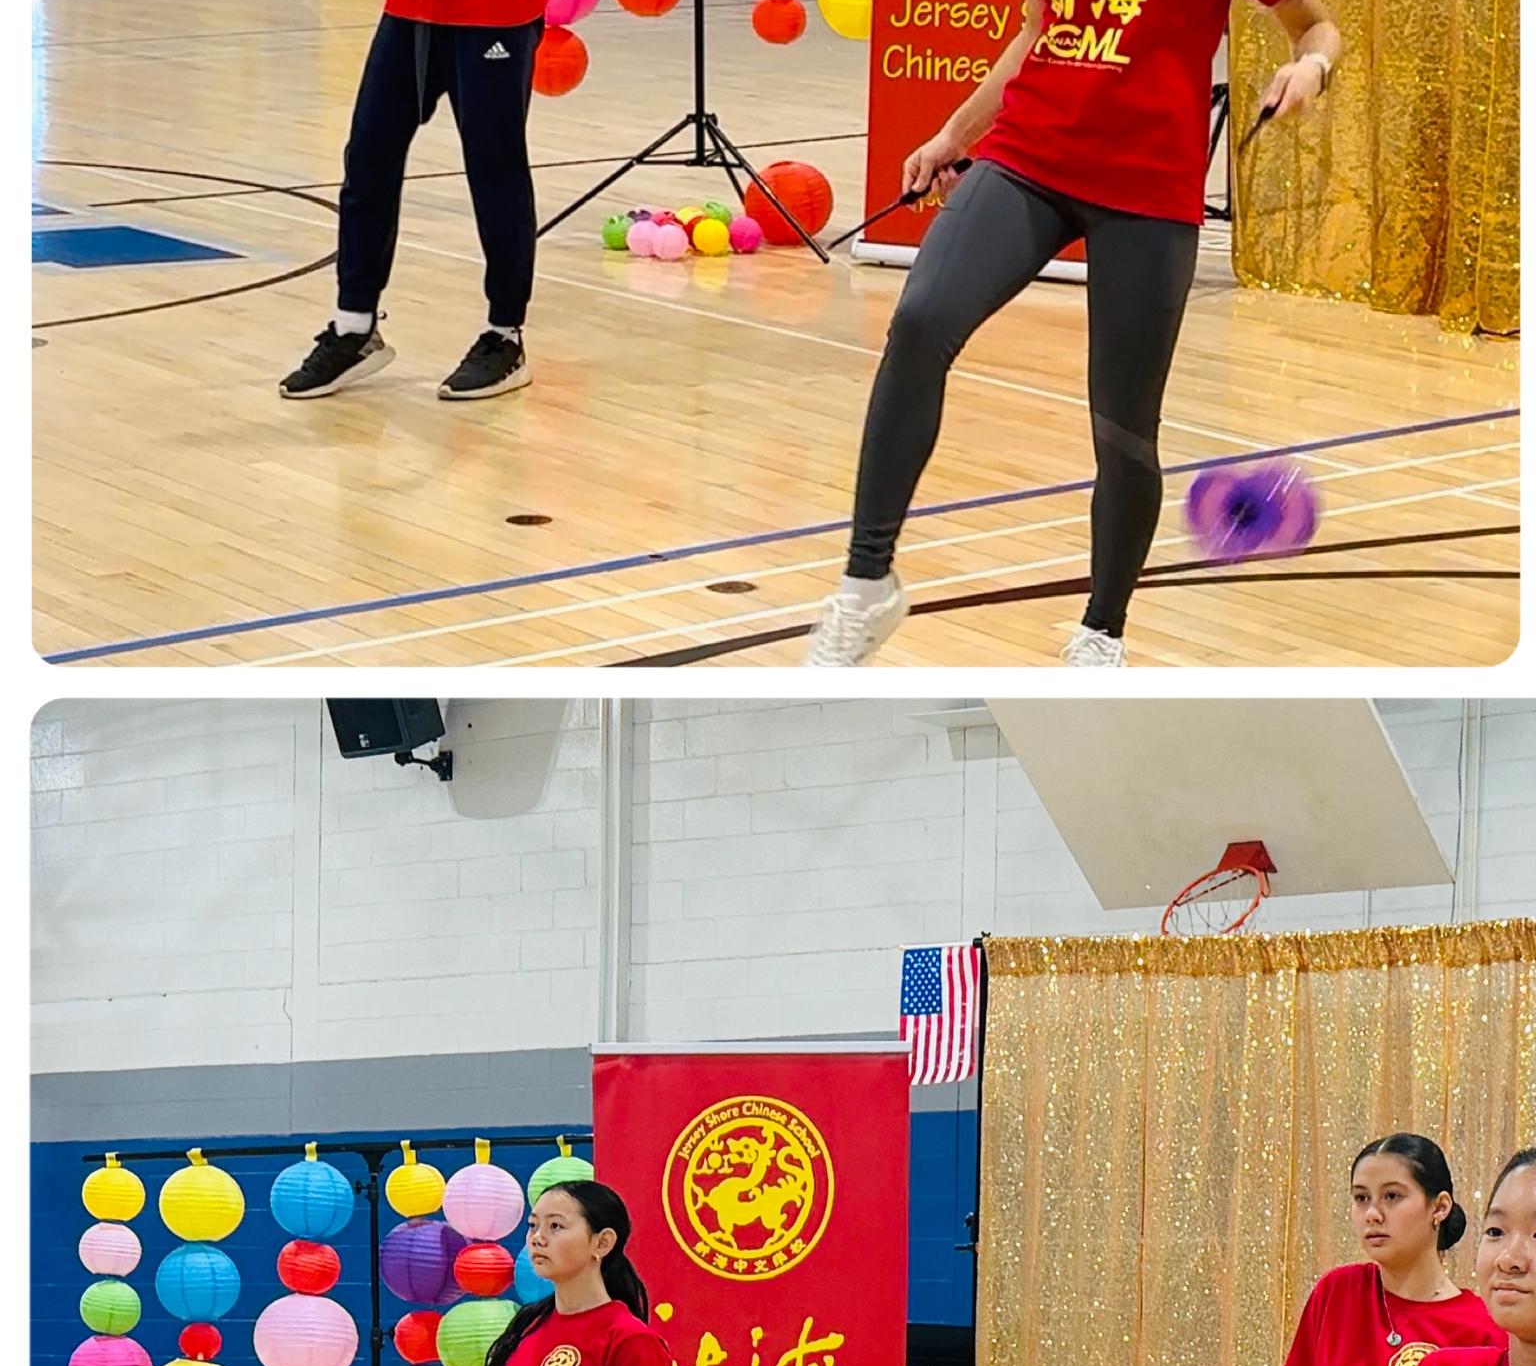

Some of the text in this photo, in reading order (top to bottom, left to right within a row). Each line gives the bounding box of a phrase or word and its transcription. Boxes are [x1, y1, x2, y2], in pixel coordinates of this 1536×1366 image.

[882, 44, 993, 83] Chines
[704, 1106, 740, 1129] Shore
[742, 1102, 788, 1125] Chinese
[787, 1118, 822, 1159] School
